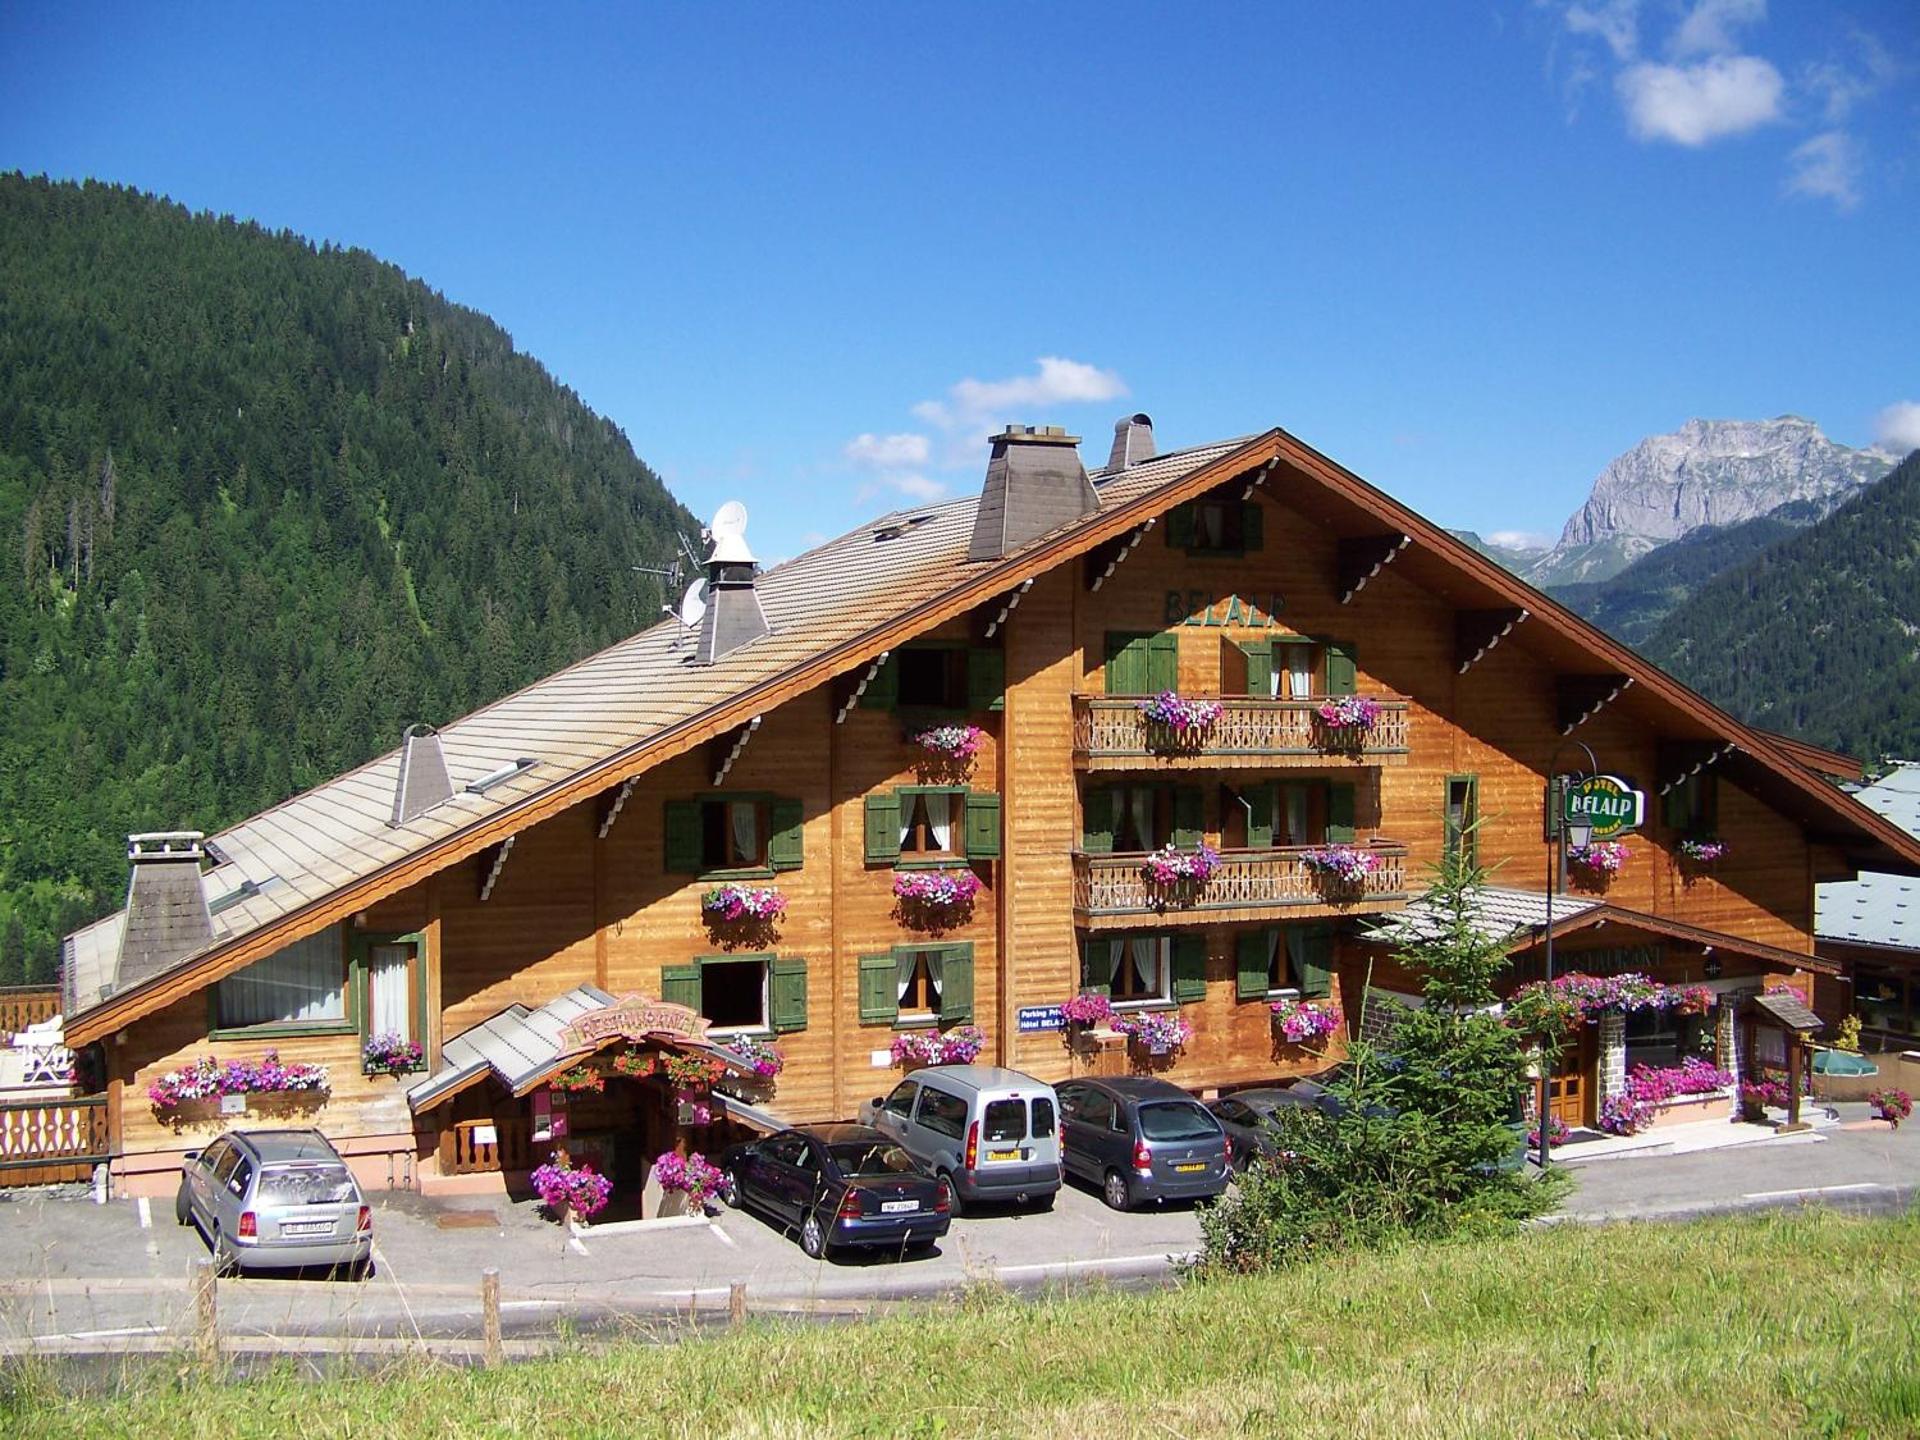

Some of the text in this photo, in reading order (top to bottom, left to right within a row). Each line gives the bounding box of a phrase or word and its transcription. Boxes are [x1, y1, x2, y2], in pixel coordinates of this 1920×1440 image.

[1167, 591, 1289, 627] BELALP
[1571, 795, 1632, 816] BELALP
[1021, 1009, 1046, 1018] Parking
